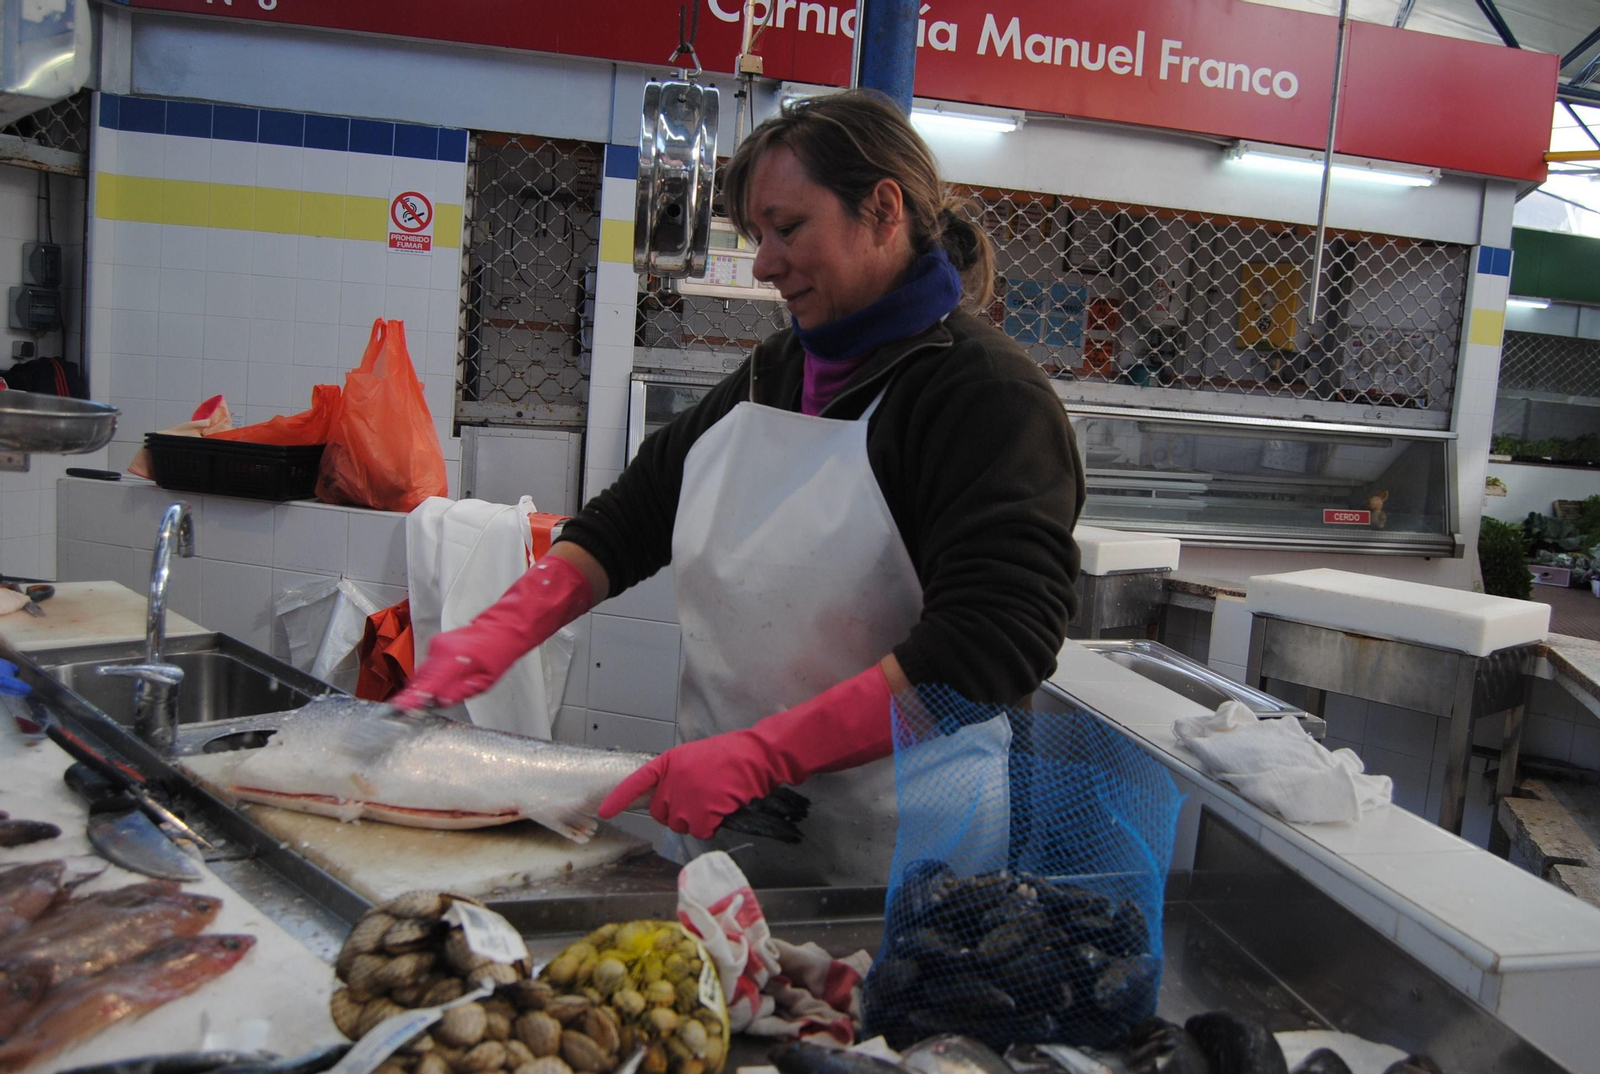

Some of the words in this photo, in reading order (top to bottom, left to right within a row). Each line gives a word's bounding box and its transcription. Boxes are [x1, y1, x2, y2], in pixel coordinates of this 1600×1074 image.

[976, 13, 1146, 77] Manuel
[1159, 38, 1299, 100] Franco
[390, 234, 429, 243] PROHIBIDO
[396, 241, 423, 249] FUMAR
[1334, 513, 1360, 521] CERDO
